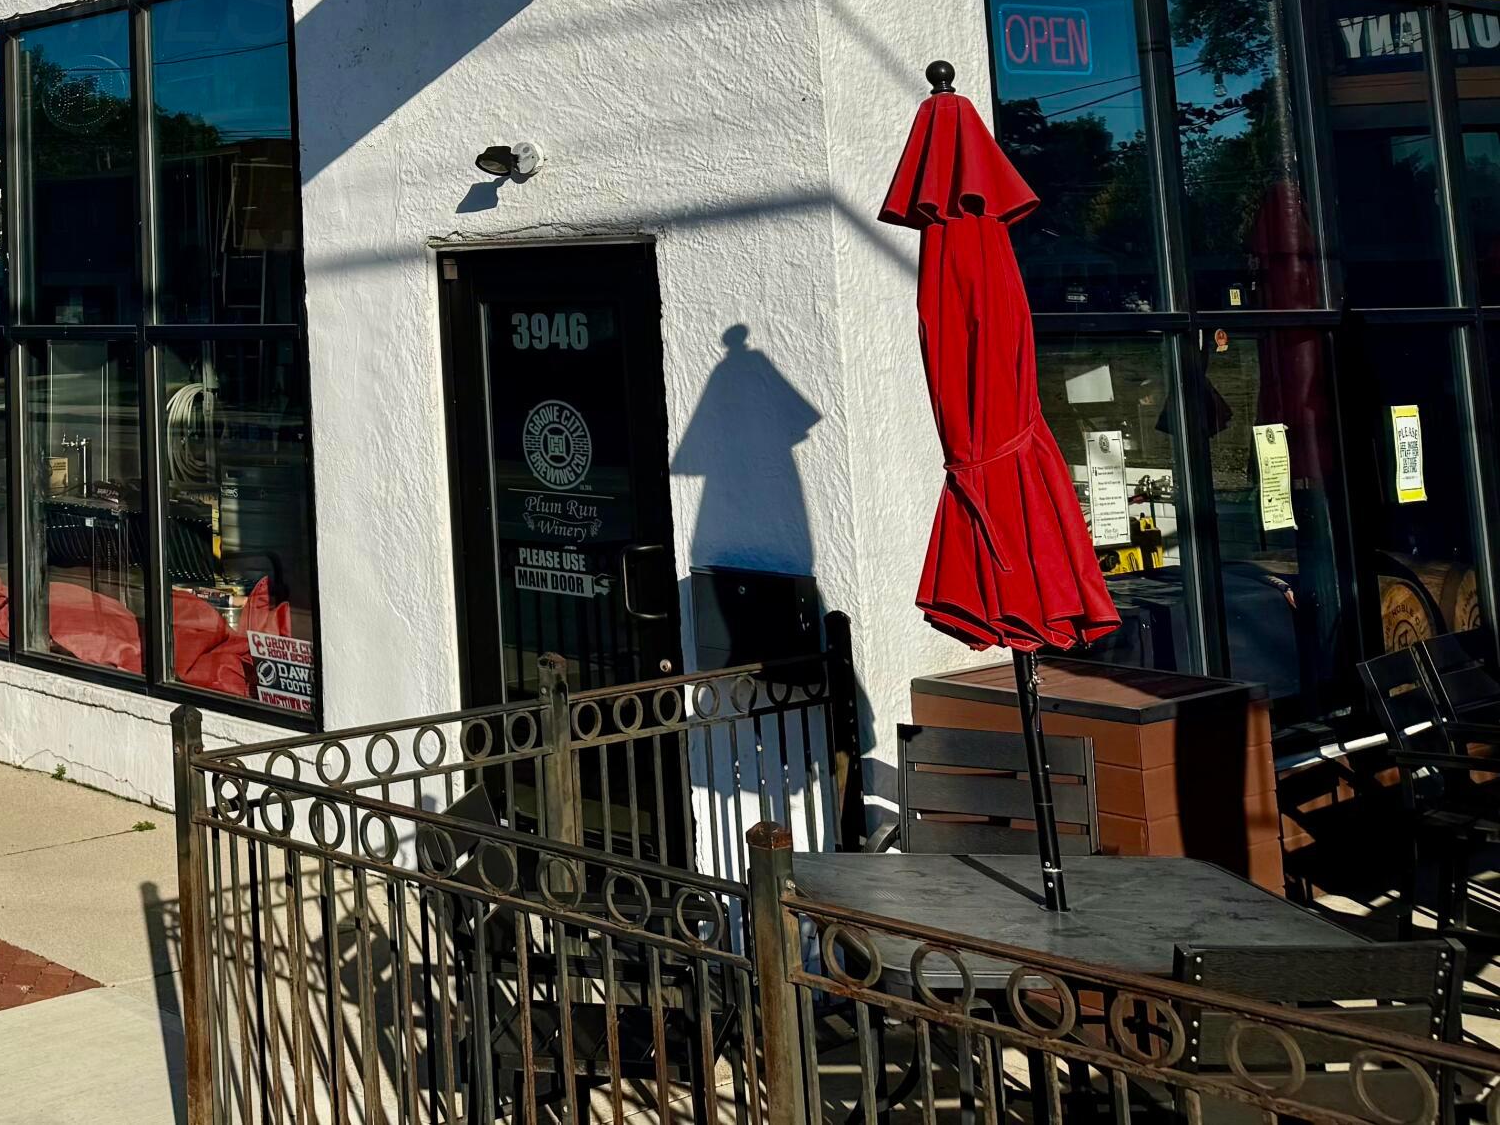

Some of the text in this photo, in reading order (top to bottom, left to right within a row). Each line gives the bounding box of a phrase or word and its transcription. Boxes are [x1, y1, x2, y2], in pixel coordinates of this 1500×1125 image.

[1005, 13, 1088, 68] OPEN
[511, 311, 590, 351] 3946
[528, 405, 586, 438] GROVE CITY
[530, 450, 576, 485] BREWING
[524, 495, 598, 520] Plum Run
[537, 520, 587, 543] Winery
[518, 547, 586, 572] PLEASE USE
[518, 569, 585, 594] MAIN DOOR
[265, 636, 298, 653] GROVE
